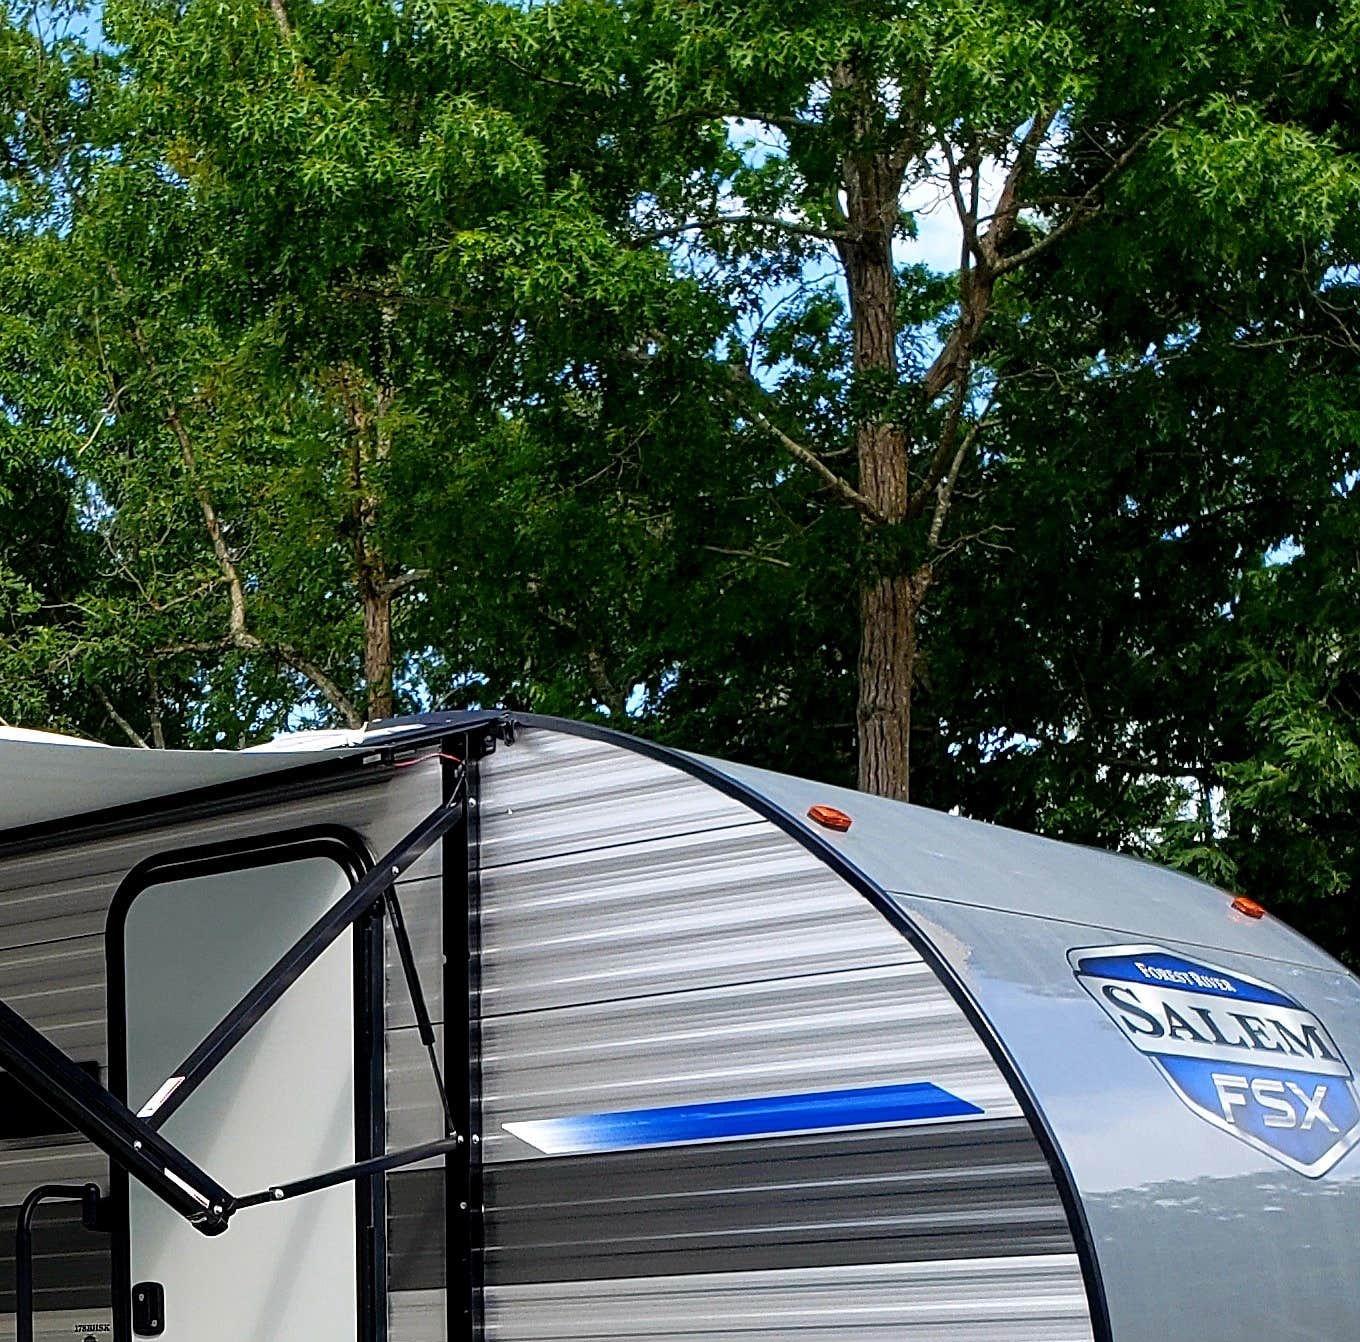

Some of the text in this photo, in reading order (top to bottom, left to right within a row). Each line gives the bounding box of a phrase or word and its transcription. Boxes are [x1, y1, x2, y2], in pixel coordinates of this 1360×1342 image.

[1134, 962, 1236, 992] FOREST RIVER
[1101, 984, 1342, 1063] SALEM
[1211, 1072, 1340, 1133] FSX
